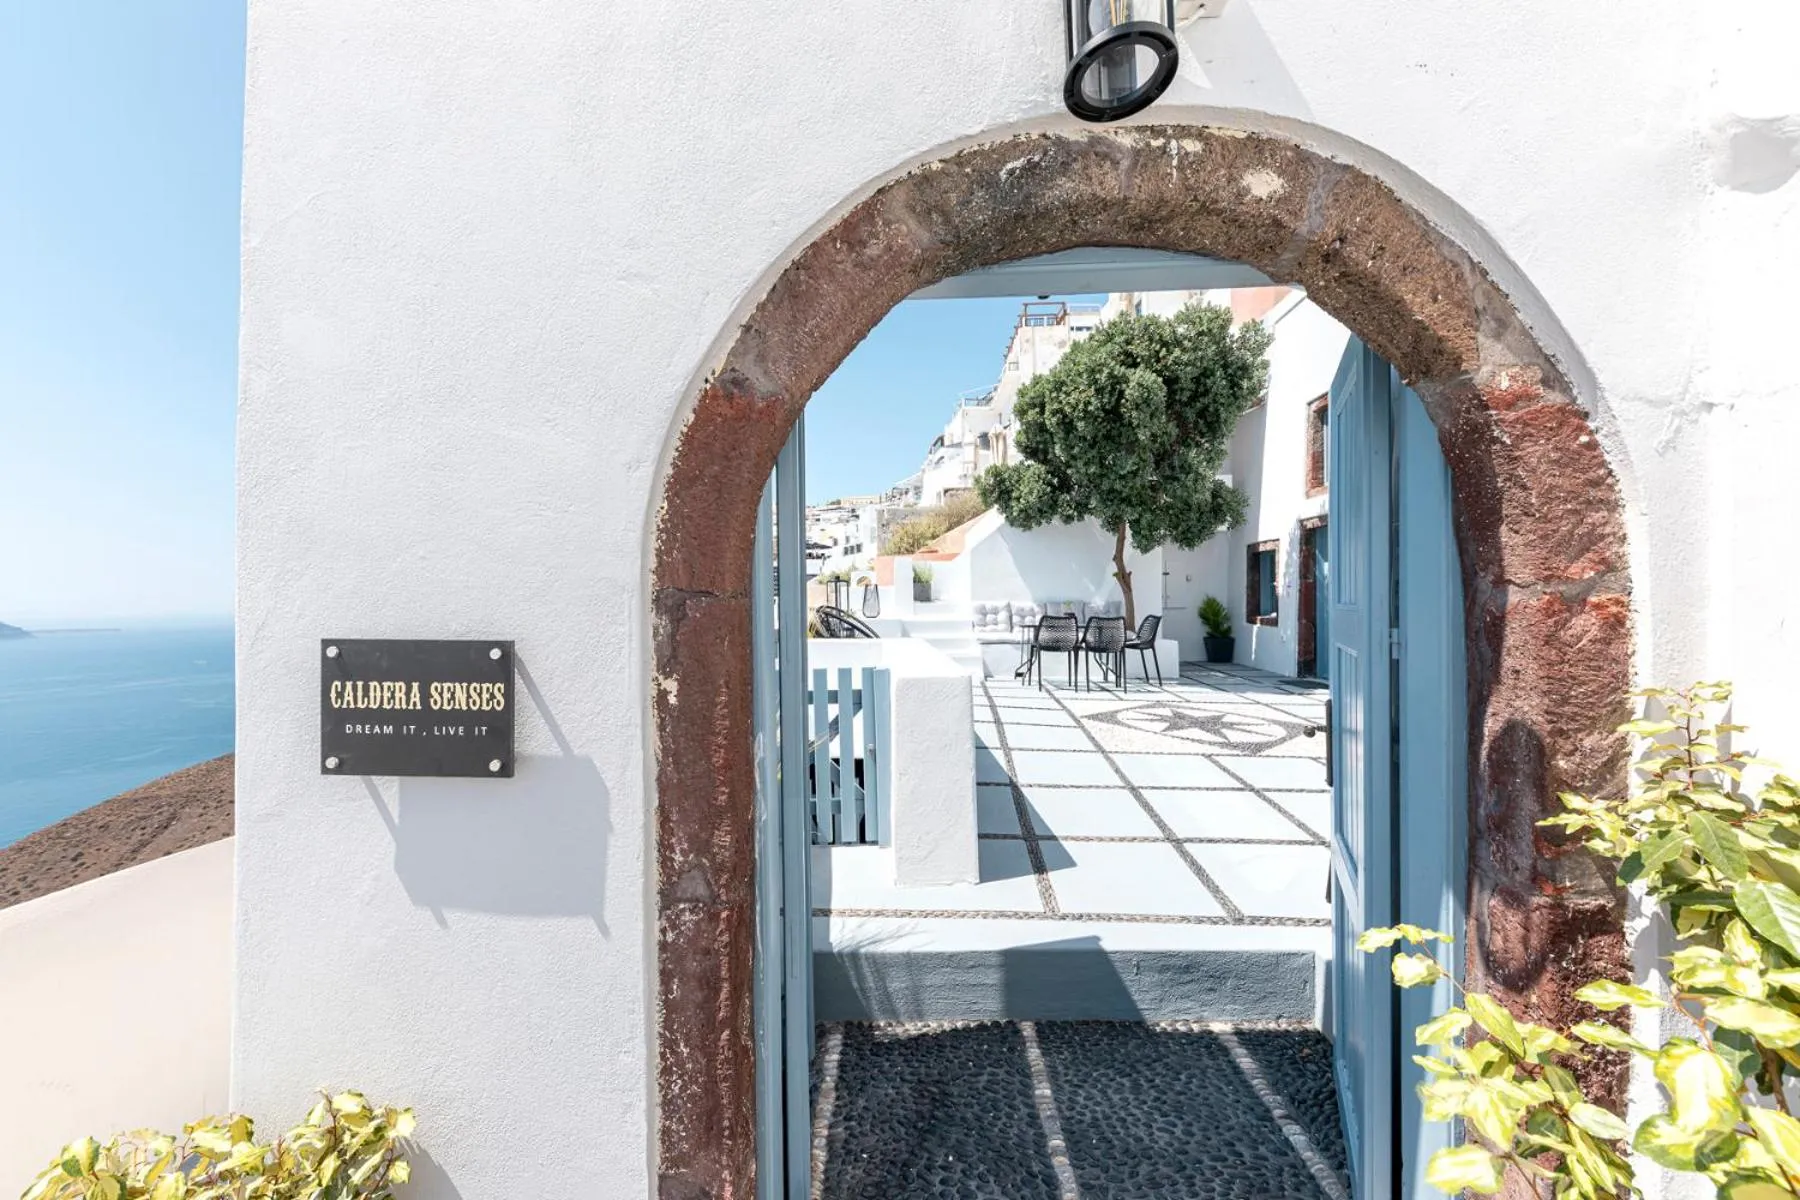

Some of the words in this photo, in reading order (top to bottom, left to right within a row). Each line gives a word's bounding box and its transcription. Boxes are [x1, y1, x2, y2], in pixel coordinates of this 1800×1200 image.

[329, 680, 423, 710] CALDERA
[429, 681, 505, 711] SENSES
[345, 723, 394, 735] DREAM
[433, 725, 465, 736] LIVE
[474, 726, 488, 736] IT
